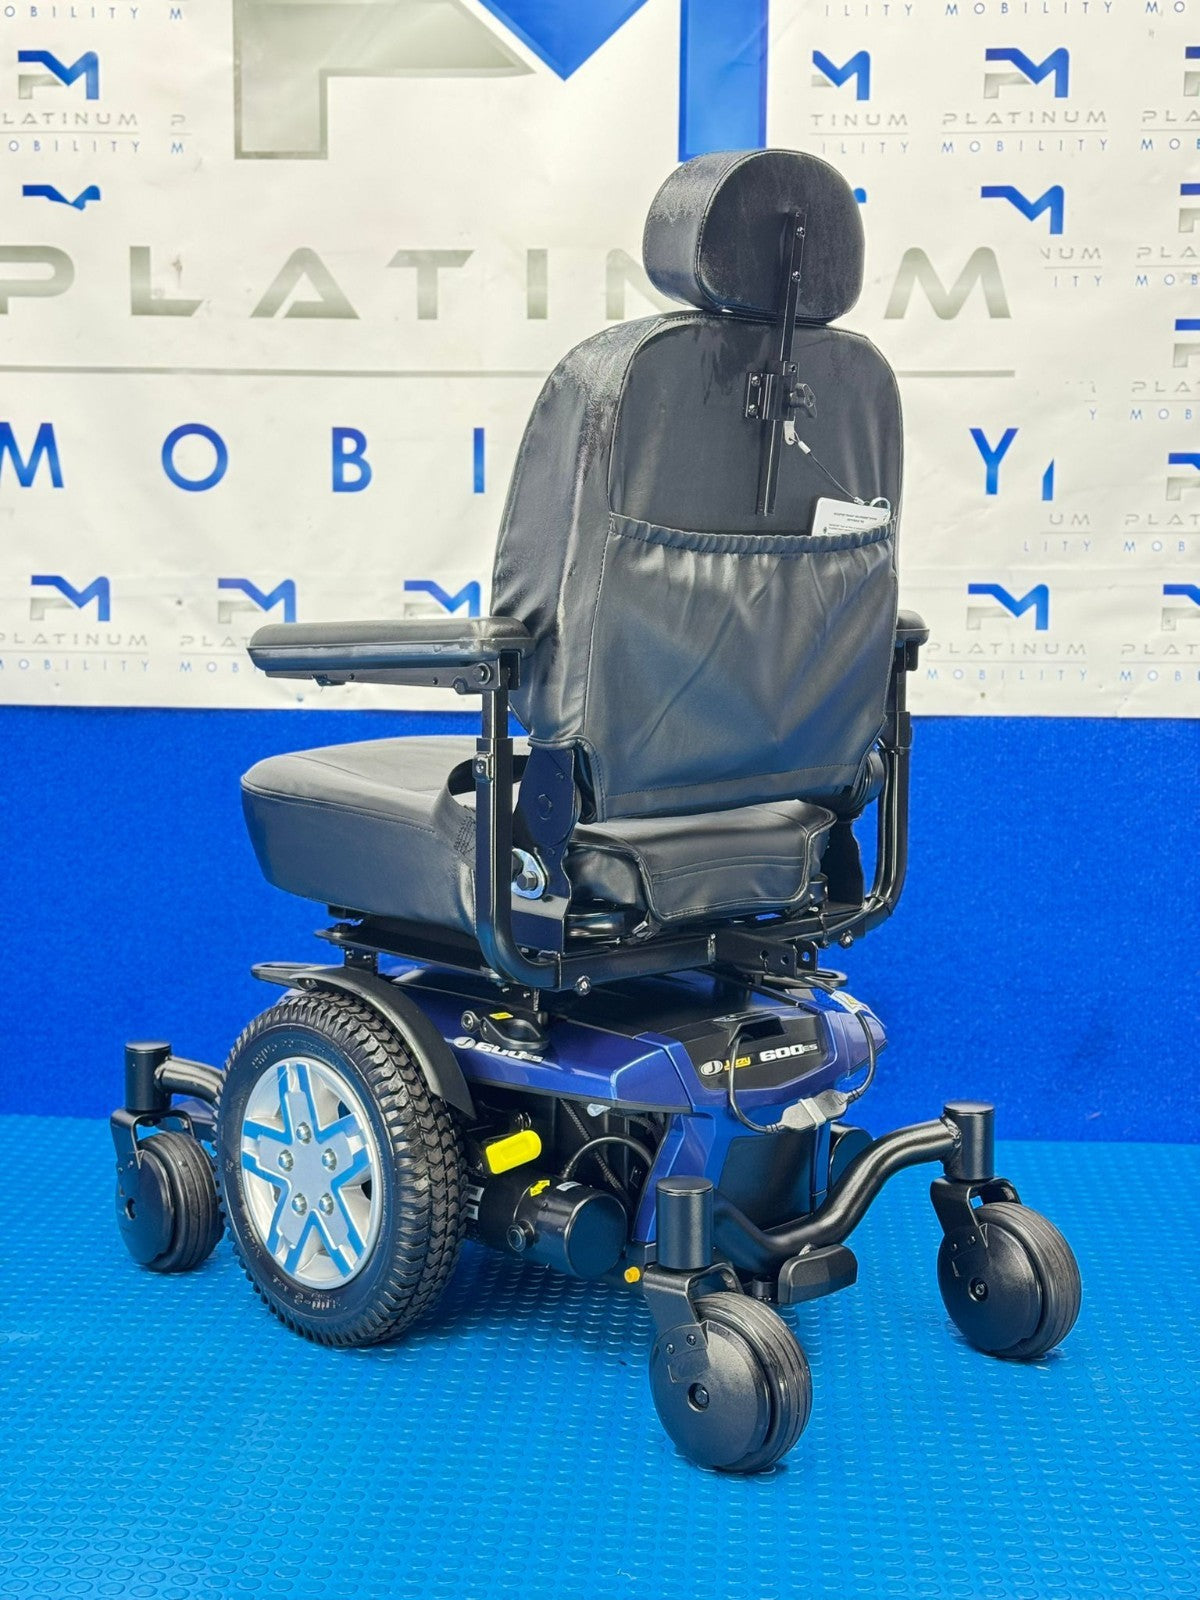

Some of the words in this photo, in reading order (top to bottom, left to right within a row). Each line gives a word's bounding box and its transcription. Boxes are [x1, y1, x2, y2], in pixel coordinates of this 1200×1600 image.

[944, 1, 1113, 15] MOBILITY
[942, 111, 1107, 125] PLATINUM
[942, 138, 1108, 153] MOBILITY
[0, 245, 1012, 321] PLATINM
[926, 642, 1088, 655] PLATINUM
[1121, 643, 1198, 655] PLAT
[926, 669, 1089, 682] MOBILITY
